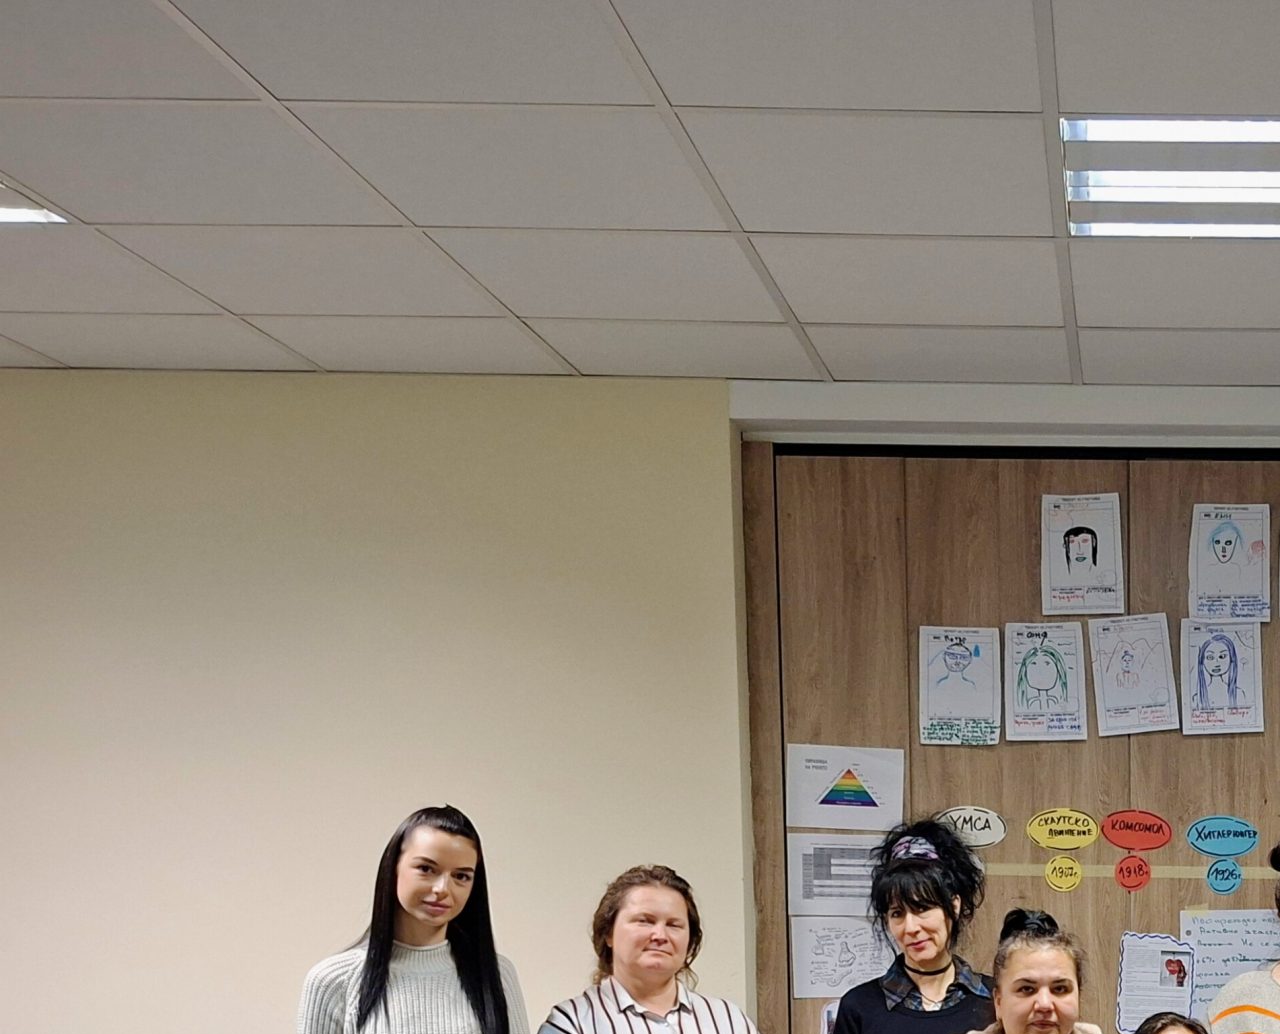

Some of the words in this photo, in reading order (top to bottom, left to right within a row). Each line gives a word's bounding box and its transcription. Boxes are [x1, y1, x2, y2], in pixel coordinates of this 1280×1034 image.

[949, 814, 992, 832] YMCA
[1037, 815, 1090, 828] СКАУТСКО
[1110, 819, 1166, 836] КОМСОМОЛ
